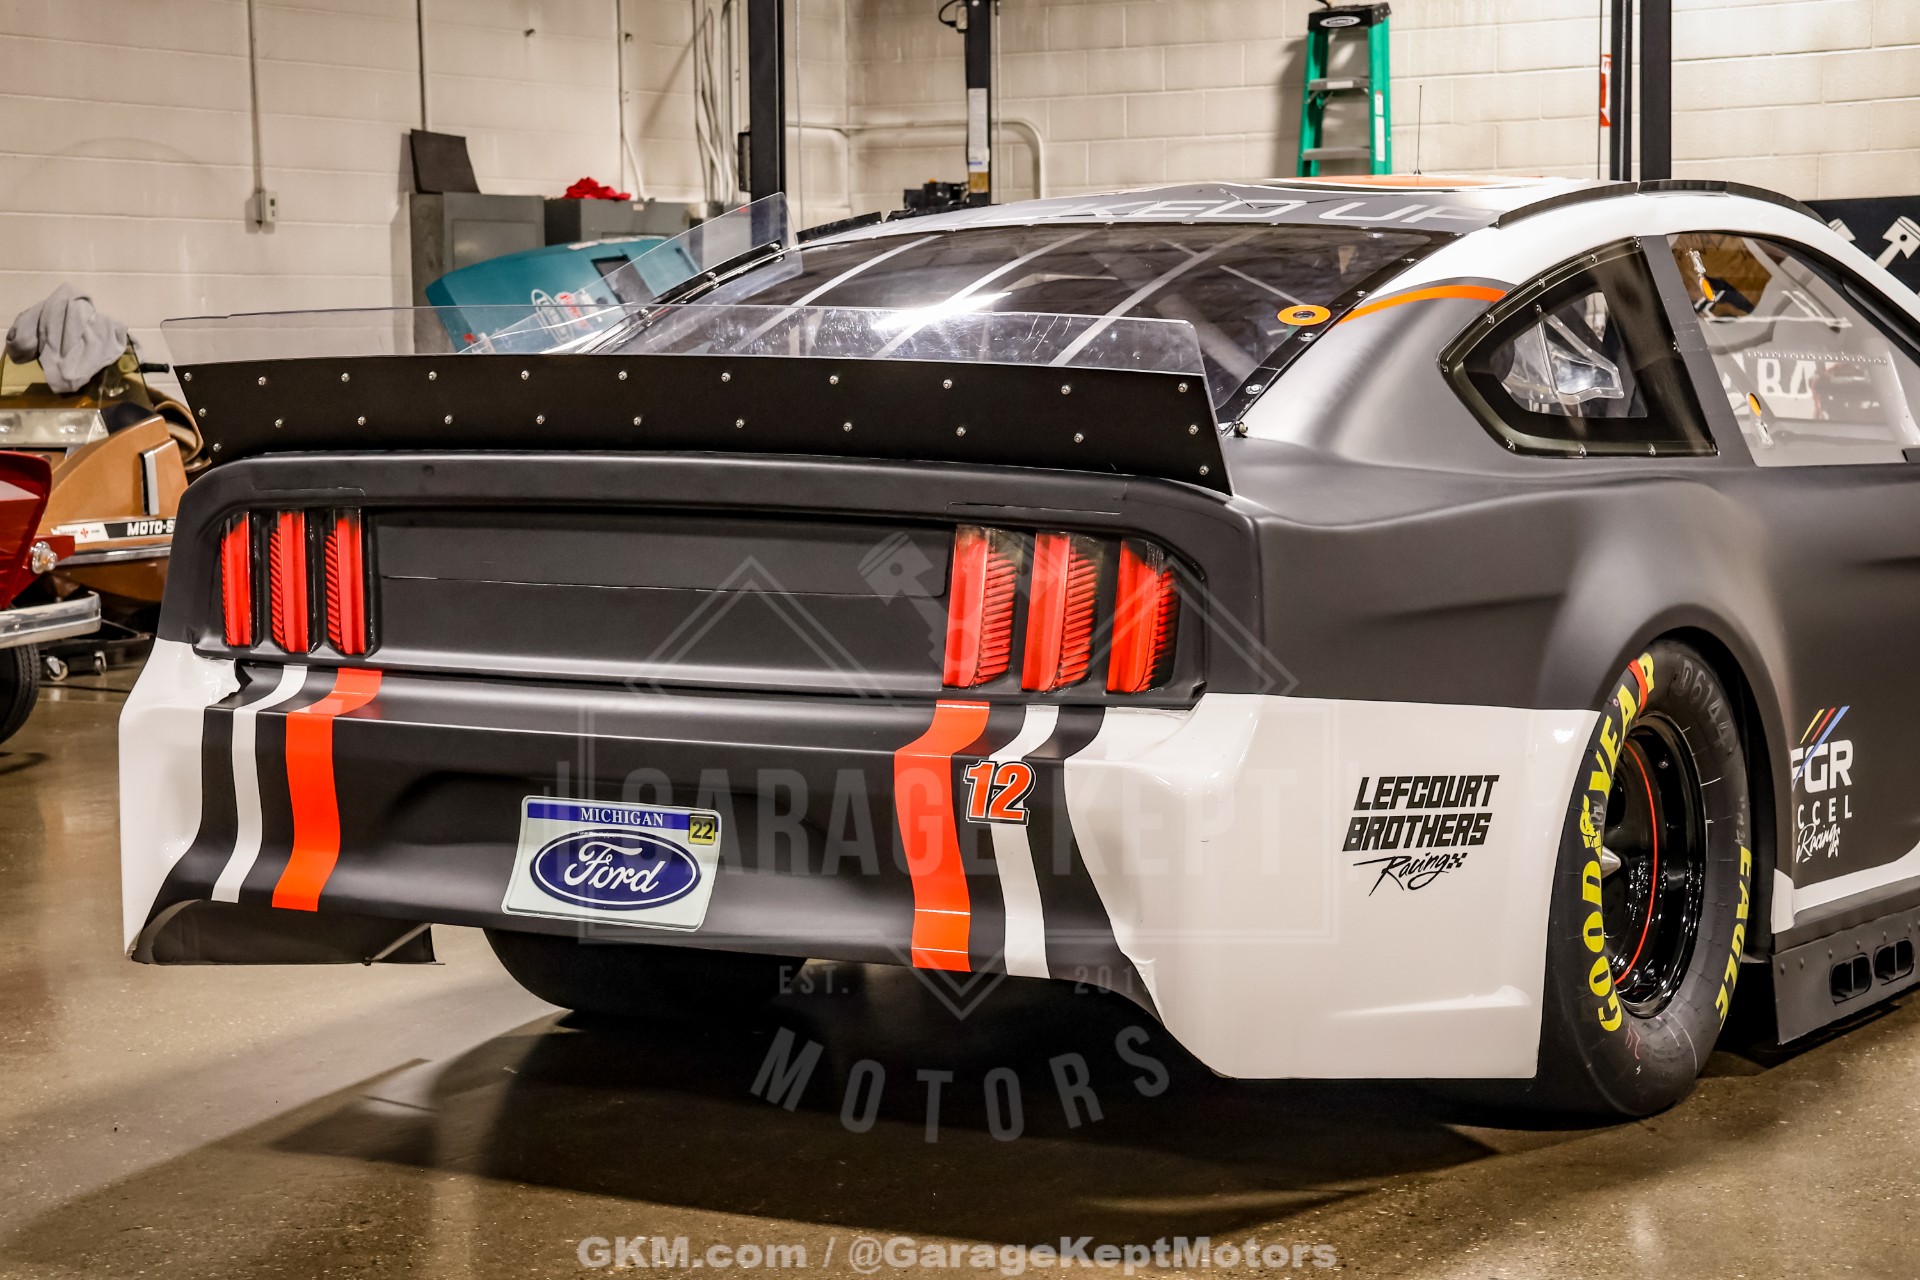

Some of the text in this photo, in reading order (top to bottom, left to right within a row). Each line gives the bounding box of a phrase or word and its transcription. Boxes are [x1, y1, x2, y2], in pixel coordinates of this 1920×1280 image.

[964, 760, 1036, 826] 12
[1353, 774, 1501, 811] LEFCOURT
[580, 807, 664, 827] MICHIGAN
[691, 820, 713, 840] 22
[1342, 812, 1493, 852] BROTHERS
[1795, 823, 1841, 863] Racing
[563, 841, 667, 894] Ford
[1353, 852, 1452, 897] Racing
[1714, 845, 1752, 1032] EAGLE
